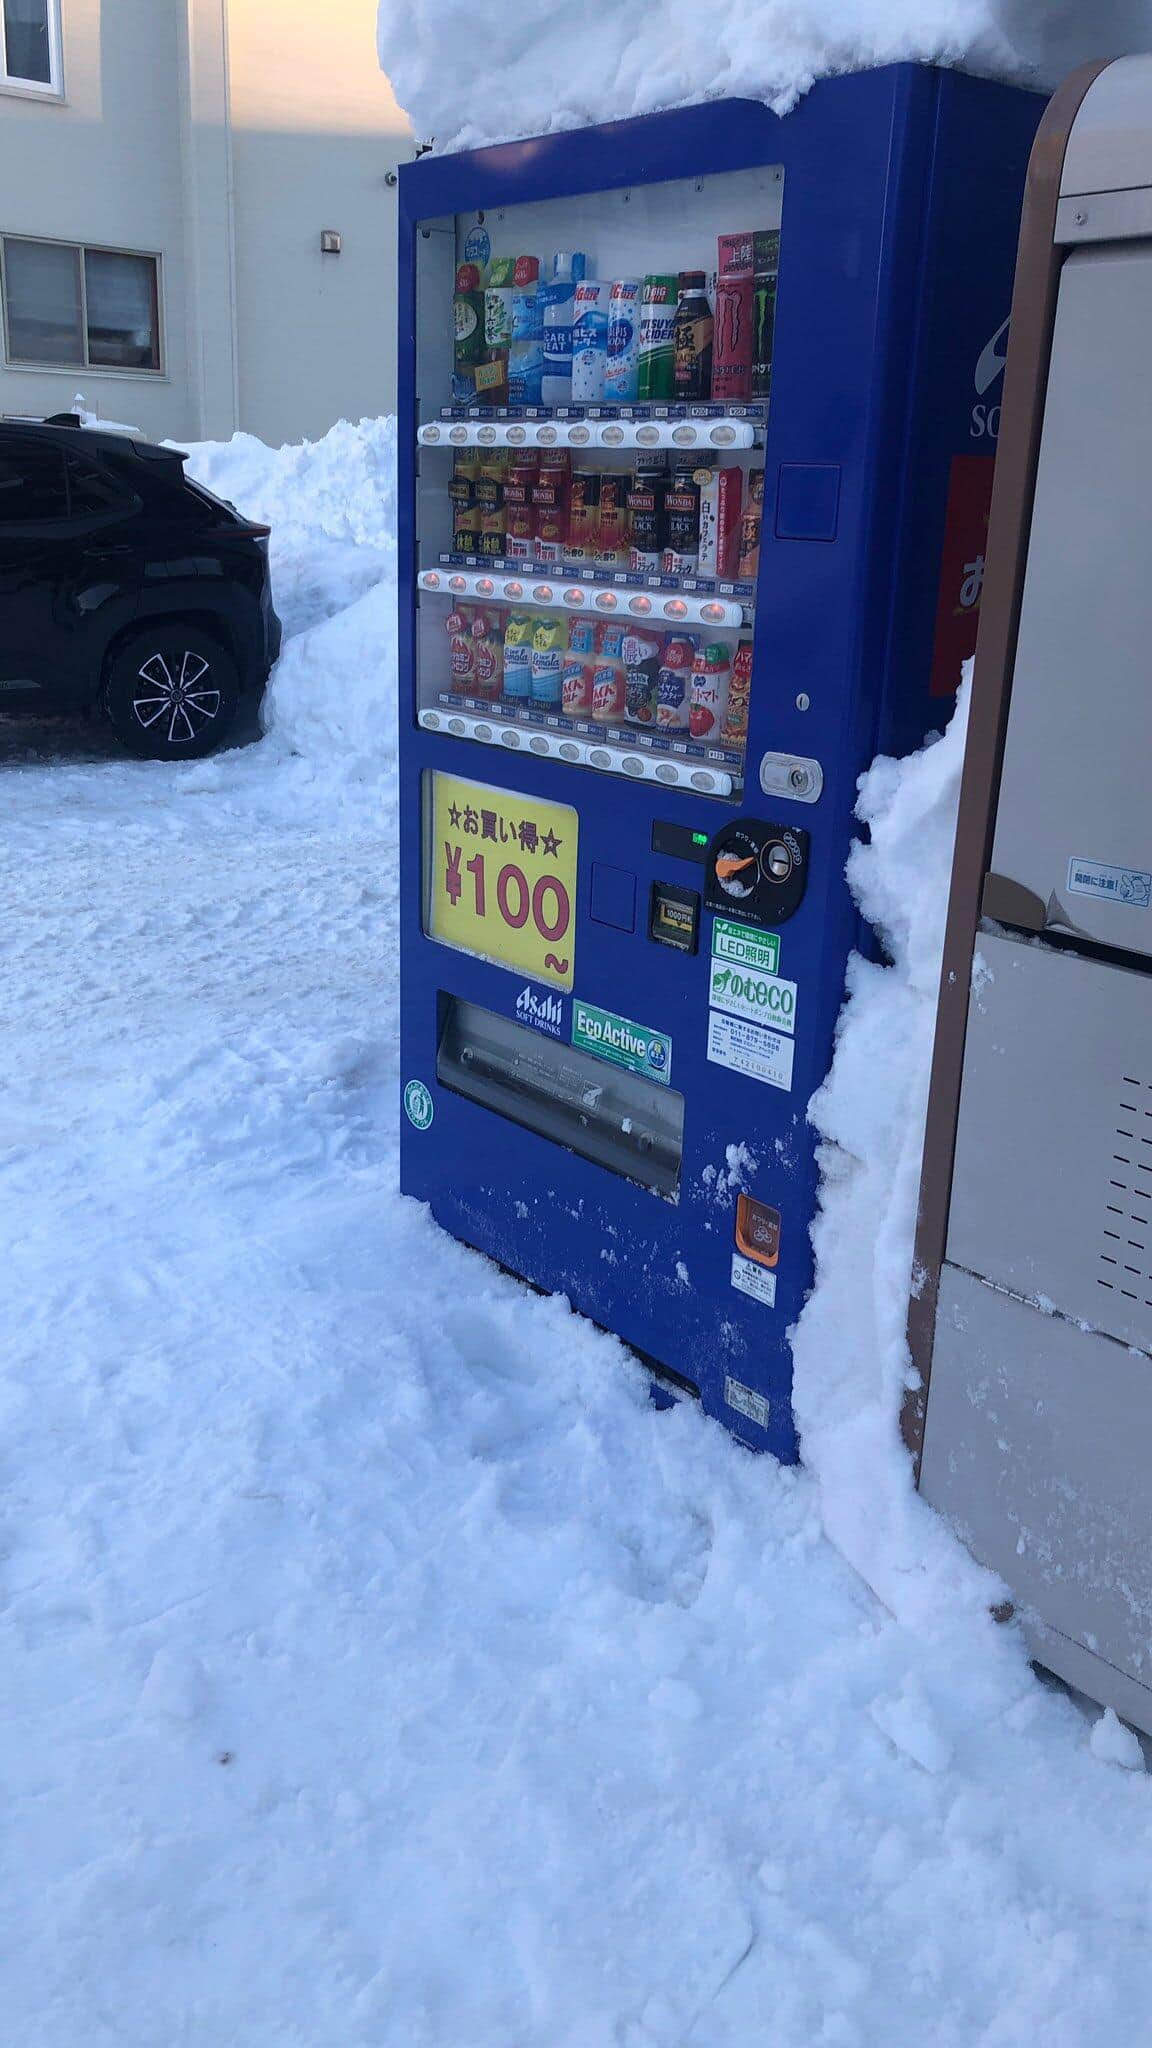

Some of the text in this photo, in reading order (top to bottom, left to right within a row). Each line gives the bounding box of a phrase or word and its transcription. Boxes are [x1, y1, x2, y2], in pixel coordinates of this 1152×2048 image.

[627, 494, 654, 508] WONDA
[665, 494, 693, 507] WONDA
[445, 841, 570, 941] ¥100
[720, 937, 770, 966] LED照明
[516, 985, 563, 1026] Asahi
[731, 974, 793, 1015] のむeco
[515, 1010, 561, 1036] SOFT DRINKS
